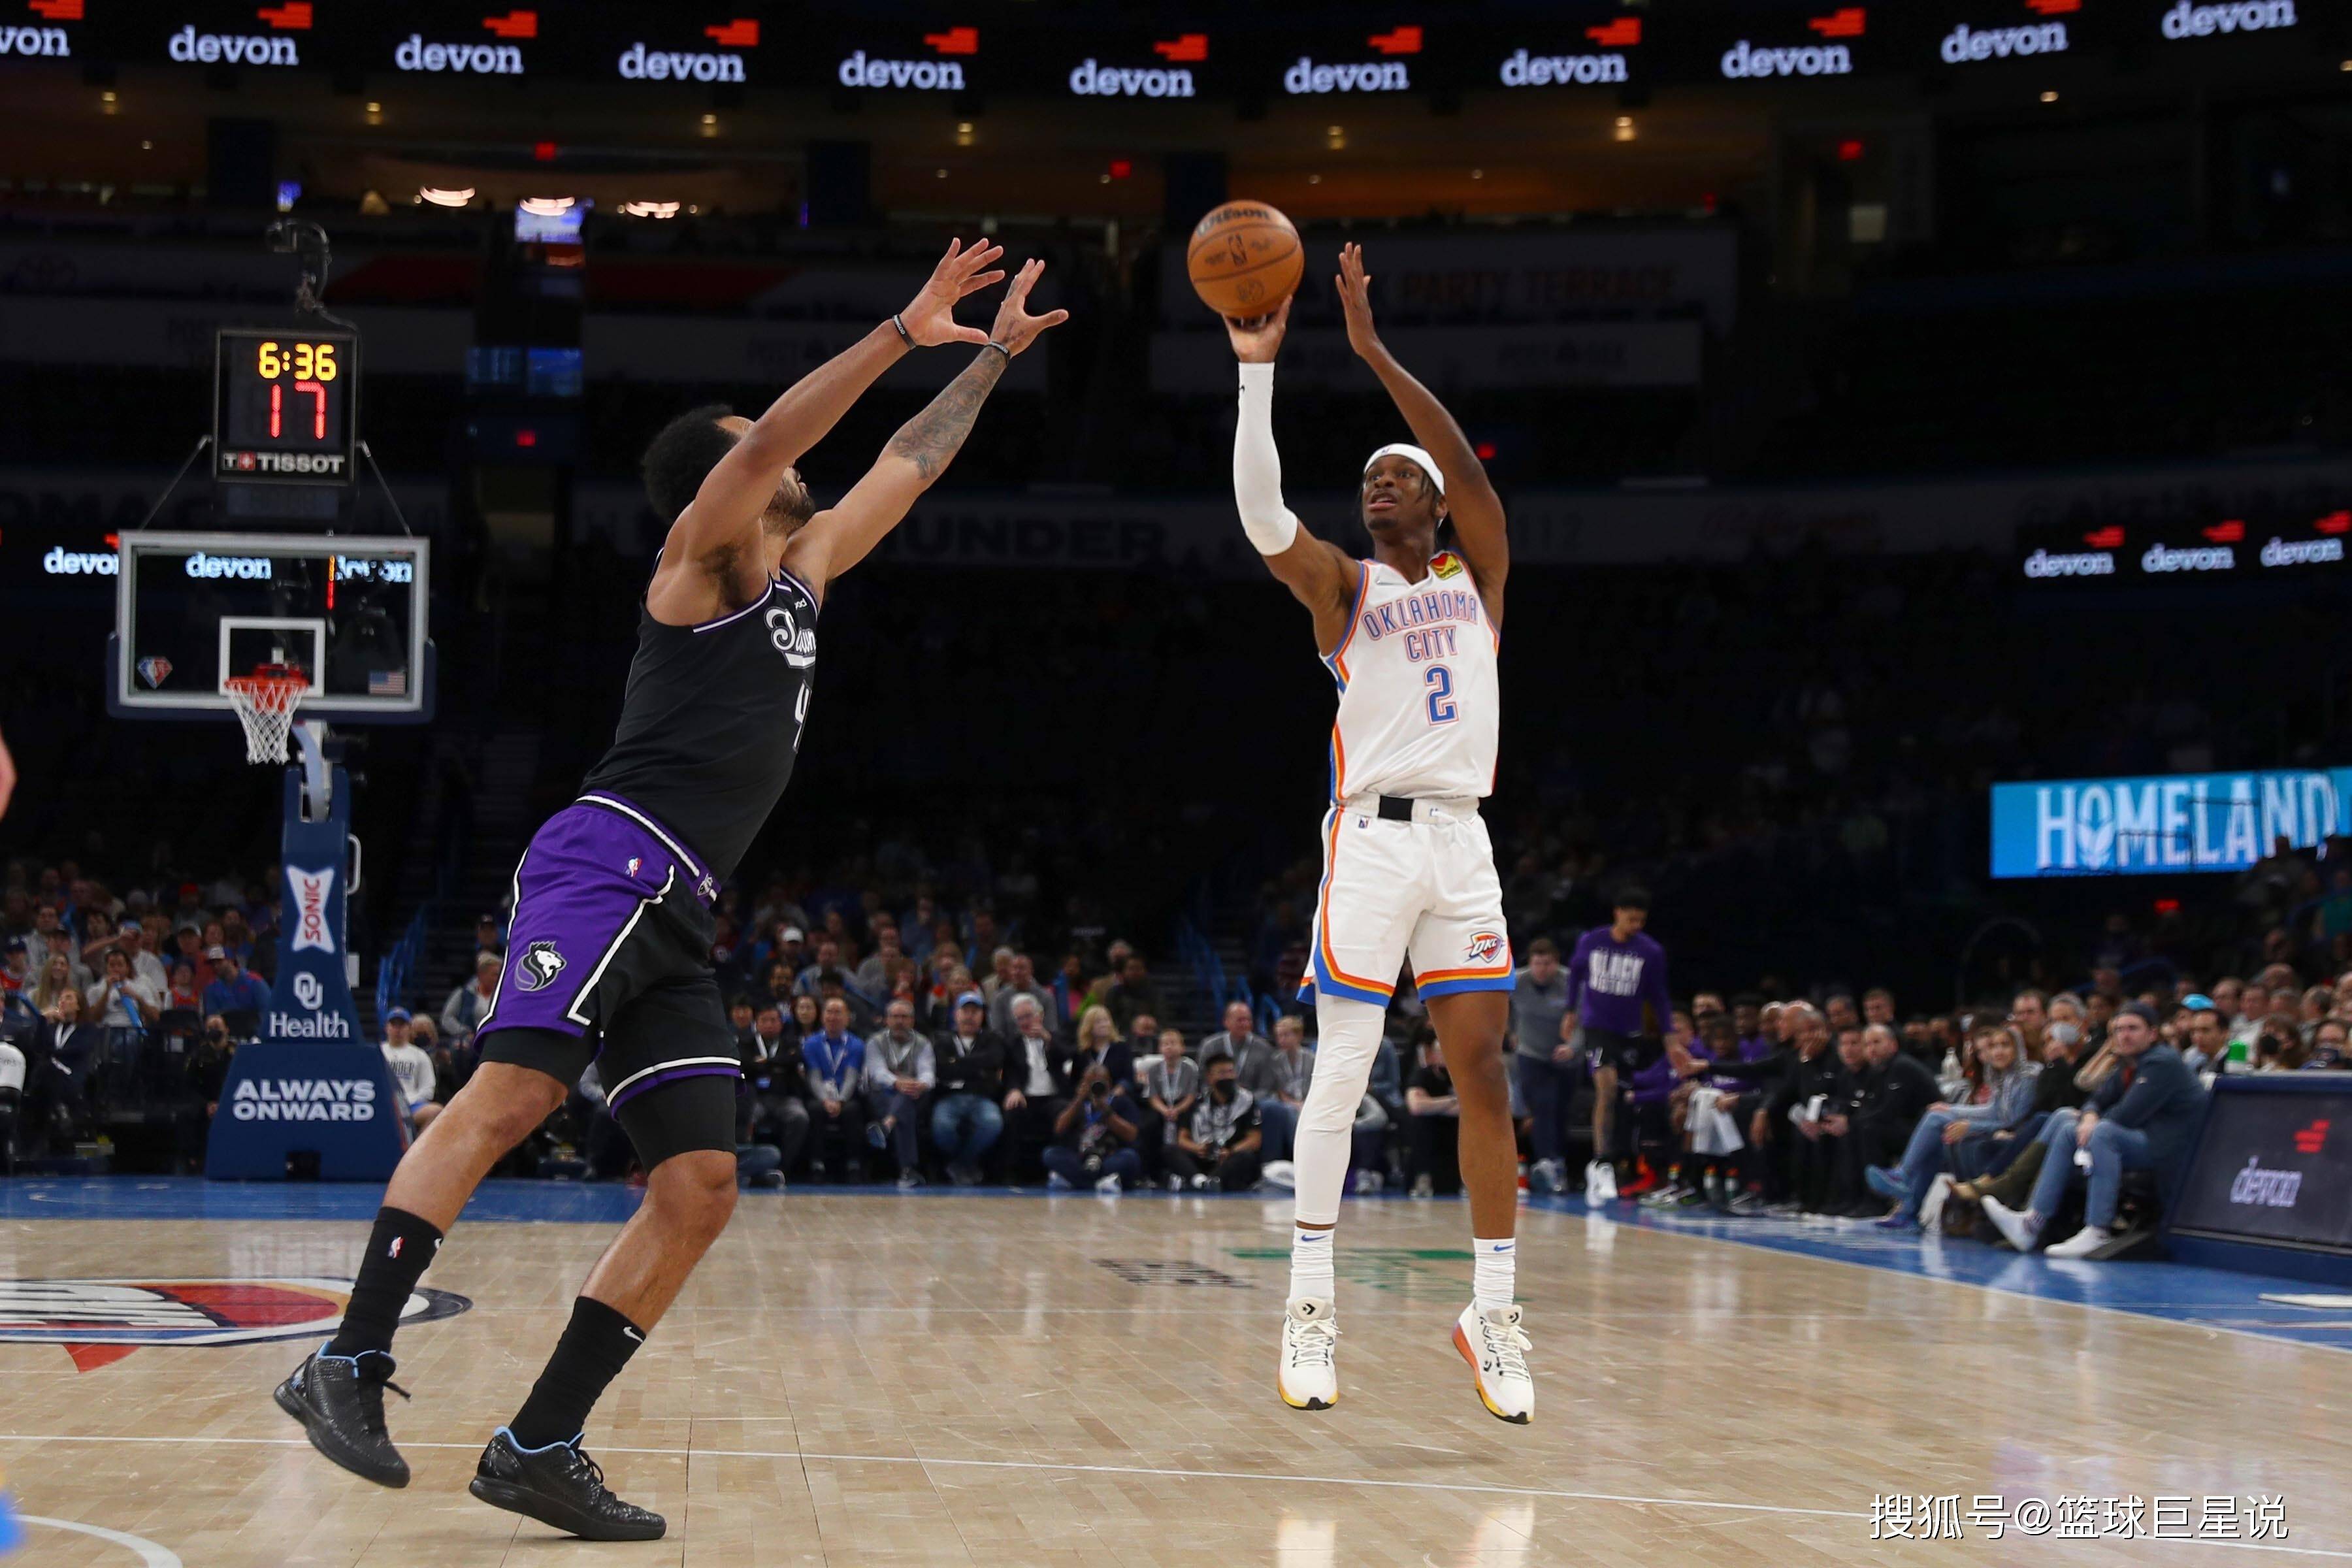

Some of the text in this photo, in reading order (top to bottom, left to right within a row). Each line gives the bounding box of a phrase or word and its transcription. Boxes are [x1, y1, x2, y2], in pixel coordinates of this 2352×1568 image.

[2162, 0, 2296, 39] devon
[169, 25, 299, 66] devon
[395, 34, 524, 74] devon
[1722, 41, 1852, 78] devon
[1941, 22, 2068, 63] devon
[619, 42, 746, 82] devon
[839, 50, 965, 90] devon
[1070, 59, 1194, 97] devon
[1284, 57, 1410, 94] devon
[1501, 49, 1629, 87] devon
[259, 342, 336, 381] 6:36
[270, 382, 325, 439] 17
[257, 453, 345, 474] TISSOT
[889, 515, 1164, 561] UNDER
[2261, 536, 2344, 567] devon
[185, 551, 272, 580] devon
[2025, 549, 2115, 578] devon
[2142, 543, 2234, 573] devon
[1361, 591, 1479, 641] OKLAHOMA
[1406, 625, 1458, 662] CITY
[1424, 663, 1460, 726] 2
[2036, 774, 2341, 870] HOMELAND
[304, 877, 322, 942] SONIC
[293, 972, 323, 1009] OU
[269, 1011, 350, 1038] Health
[233, 1079, 376, 1102] ALWAYS
[233, 1101, 374, 1122] ONWARD
[2230, 1154, 2302, 1207] devon
